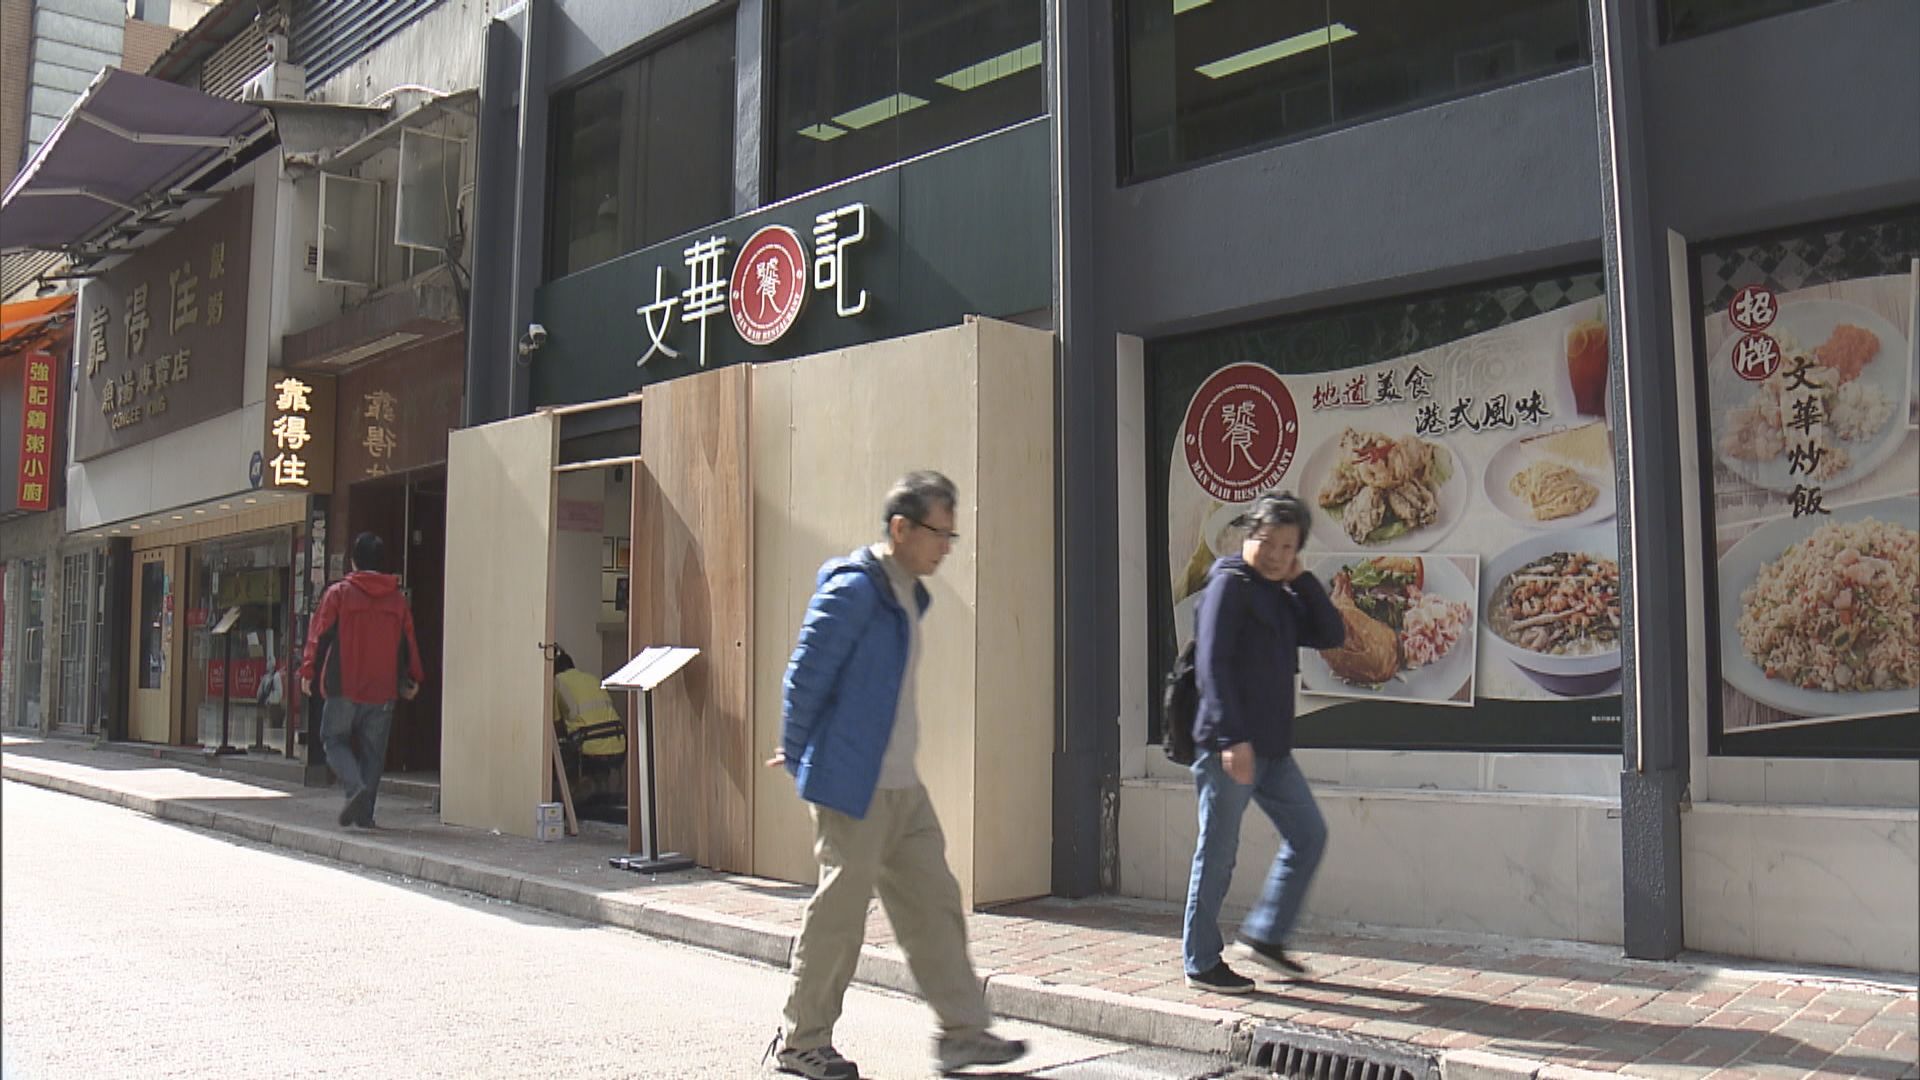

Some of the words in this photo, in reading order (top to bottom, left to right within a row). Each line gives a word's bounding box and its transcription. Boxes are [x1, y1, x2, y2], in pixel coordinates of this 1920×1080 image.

[86, 261, 198, 377] 靠得住
[1735, 289, 1777, 375] 招牌
[1312, 364, 1433, 410] 地道美食
[1415, 389, 1550, 434] 港式風味
[269, 377, 313, 486] 靠得住
[1191, 459, 1211, 486] MAN
[1209, 481, 1231, 500] WAH
[1233, 448, 1293, 501] RESTAURANT
[1782, 356, 1832, 520] 文華炒飯
